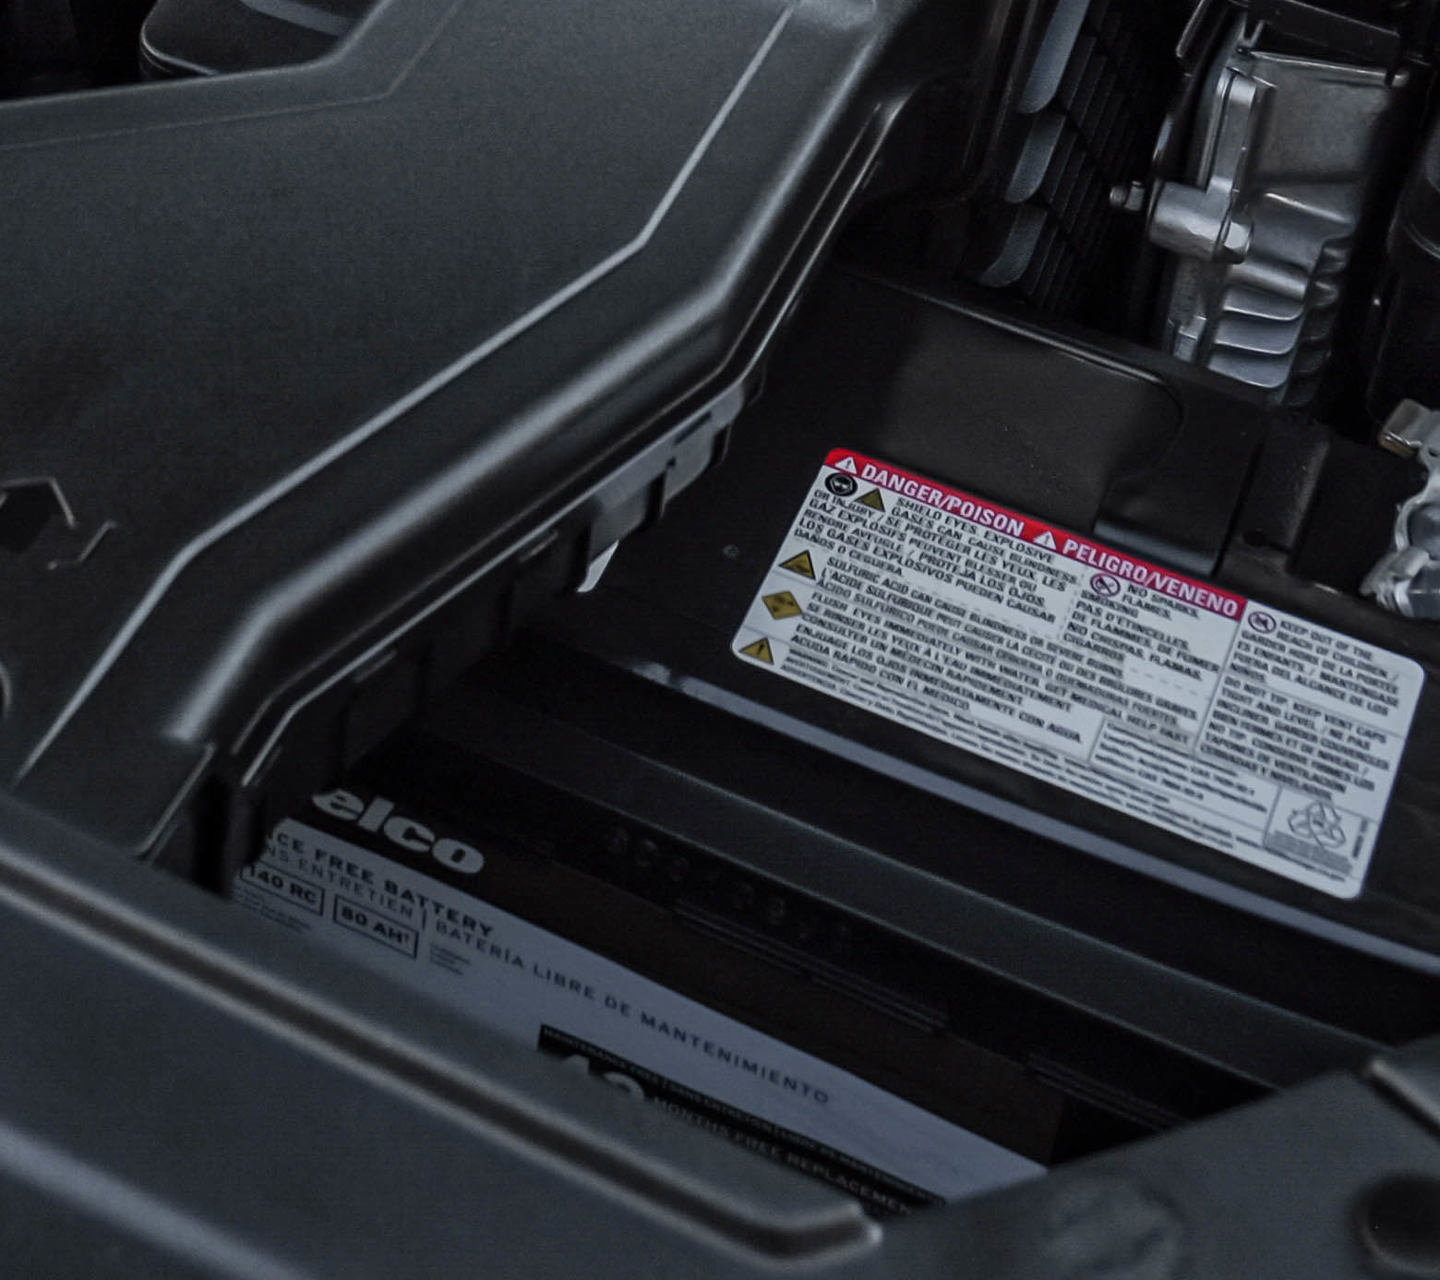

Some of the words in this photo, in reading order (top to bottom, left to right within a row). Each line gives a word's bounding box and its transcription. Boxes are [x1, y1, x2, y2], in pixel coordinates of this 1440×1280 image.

[808, 498, 835, 514] GAZ
[837, 509, 907, 542] EXPLOSIFS
[908, 536, 962, 563] PEUVENT
[831, 495, 875, 518] INJURY
[885, 516, 902, 529] SE
[973, 549, 998, 565] LES
[860, 463, 1025, 536] DANGER/POISON
[1061, 538, 1239, 618] PELIGRO/VENENO
[890, 506, 934, 530] GASES
[936, 524, 963, 540] CAN
[967, 535, 1005, 557] CAUSE
[895, 497, 942, 521] SHIELD
[983, 529, 1053, 563] EXPLOSIVE
[798, 517, 824, 534] LOS
[825, 528, 871, 552] GASES
[872, 546, 954, 584] EXPLOSIVOS
[955, 577, 1004, 603] PUEDEN
[1005, 597, 1057, 623] CAUSAR
[826, 556, 881, 584] SULFURIC
[880, 577, 909, 595] ACID
[909, 588, 933, 604] CAN
[933, 597, 967, 617] CAUSE
[979, 574, 1006, 592] LOS
[1126, 583, 1148, 599] NO
[1066, 621, 1088, 637] NO
[1075, 599, 1103, 618] PAS
[312, 789, 486, 875] elco
[266, 828, 306, 854] CE
[312, 848, 377, 885] FREE
[380, 880, 494, 938] BATTERY
[287, 882, 318, 904] RC
[339, 905, 368, 927] 80
[530, 963, 596, 1002] LIBRE
[602, 994, 634, 1019] DE
[638, 1012, 832, 1104] MANTENIMIENTO
